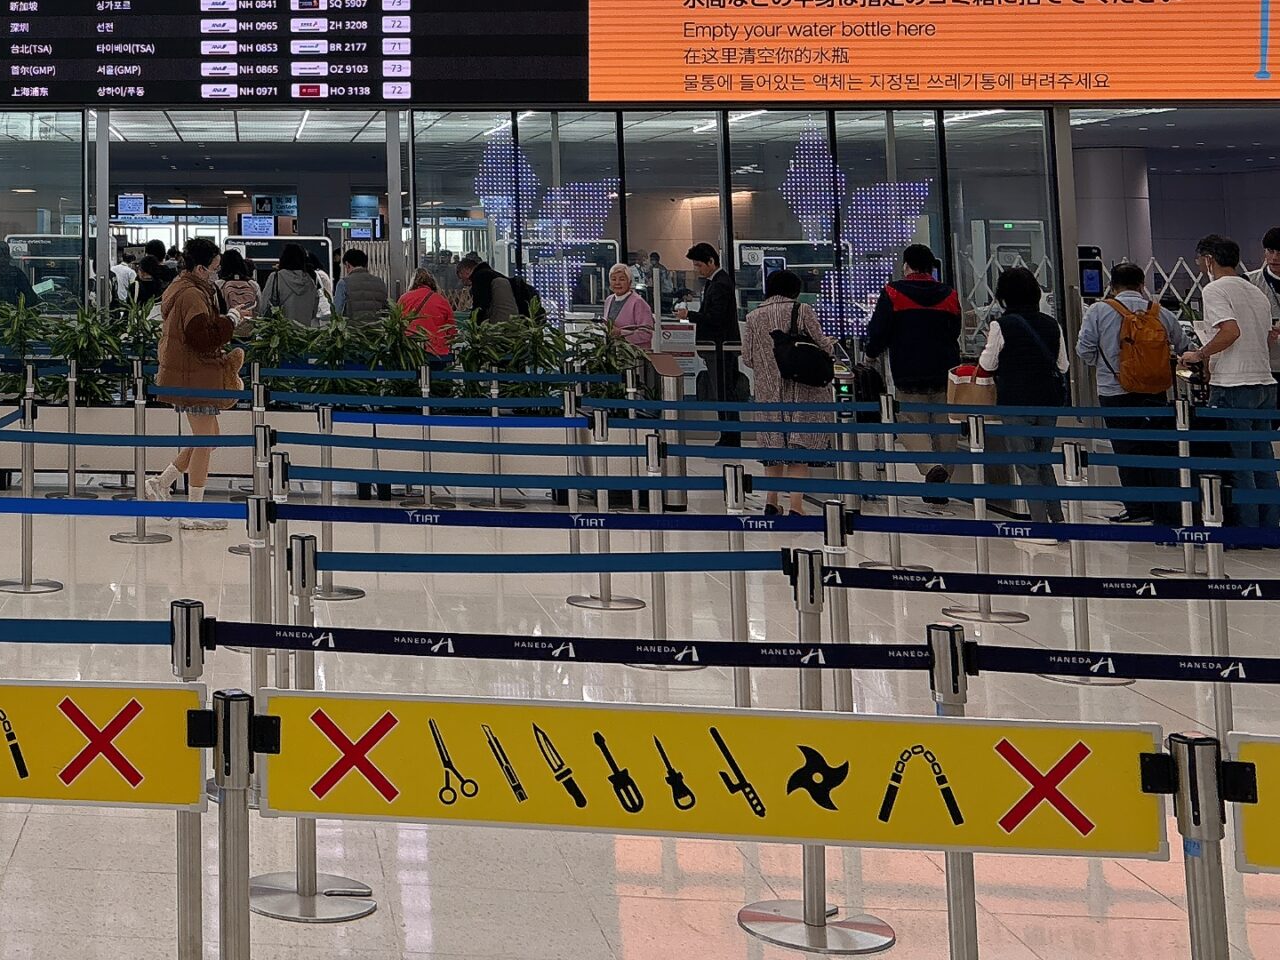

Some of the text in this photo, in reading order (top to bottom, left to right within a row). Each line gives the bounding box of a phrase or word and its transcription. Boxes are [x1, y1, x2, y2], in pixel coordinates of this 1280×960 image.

[10, 2, 38, 12] 新加坡
[96, 0, 131, 11] 싱가포르
[239, 0, 277, 8] NH 0841
[330, 0, 368, 8] SQ 5907
[391, 20, 402, 28] 72
[684, 20, 936, 41] Empty your water bottle here
[10, 44, 52, 54] 台北(TSA)
[96, 44, 154, 54] 타이베이(TSA)
[239, 44, 278, 52] NH 0853
[391, 42, 401, 50] 71
[683, 47, 850, 64] 在这里清空你的水瓶
[10, 66, 56, 76] 首尔(GMP)
[97, 65, 141, 76] 서울(GMP)
[684, 72, 1110, 91] 물통에 들어있는 액체는 지정된 쓰레기통에 버려주세요
[240, 88, 278, 96] NH 0971
[415, 514, 440, 523] TIAT
[579, 518, 606, 526] TIAT
[747, 520, 774, 528] TIAT
[1003, 527, 1032, 536] TIAT
[892, 574, 927, 582] HANEDA
[276, 630, 314, 638] HANEDA
[394, 636, 432, 644] HANEDA
[636, 645, 676, 653] HANEDA
[761, 648, 802, 656] HANEDA
[888, 650, 930, 658] HANEDA
[1050, 656, 1092, 664] HANEDA
[1180, 661, 1222, 669] HANEDA
